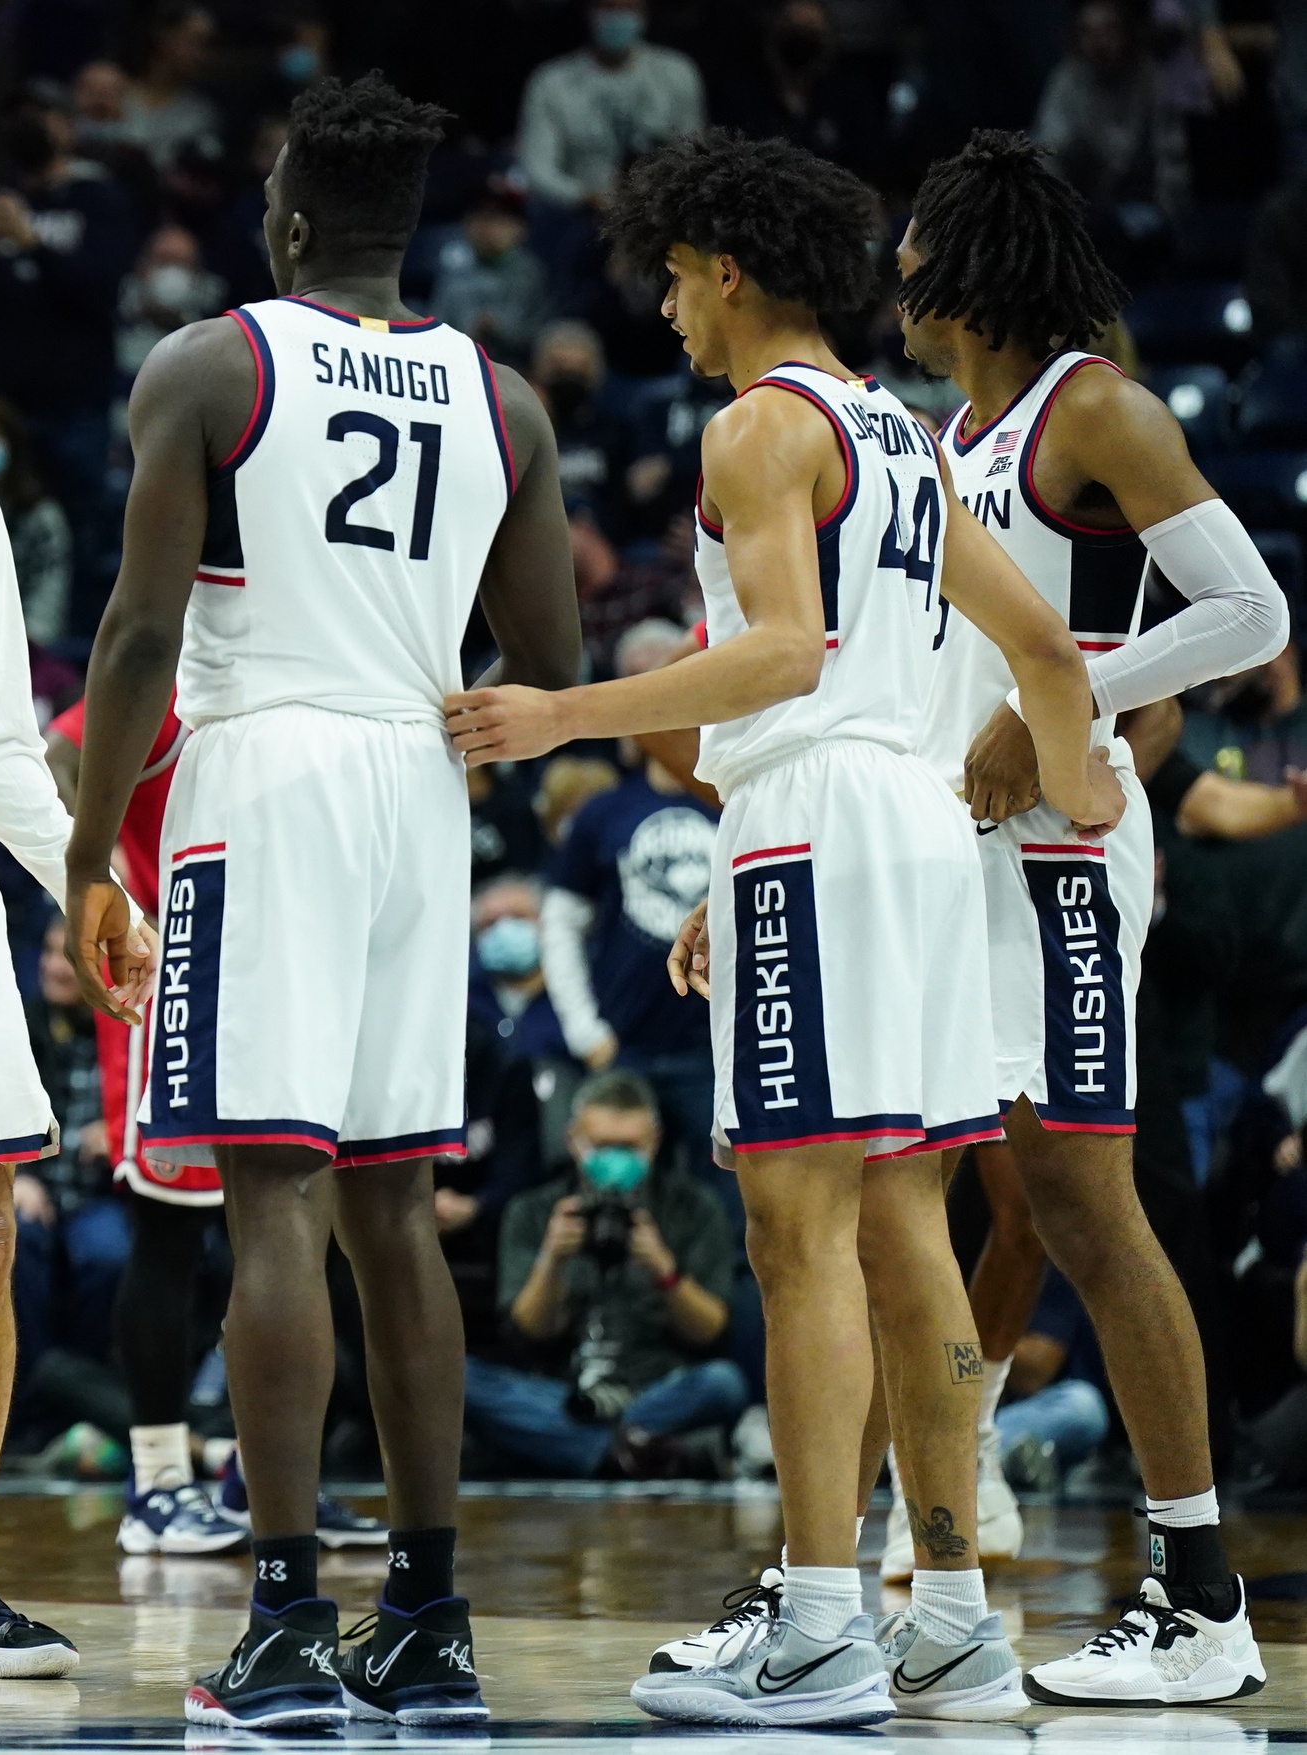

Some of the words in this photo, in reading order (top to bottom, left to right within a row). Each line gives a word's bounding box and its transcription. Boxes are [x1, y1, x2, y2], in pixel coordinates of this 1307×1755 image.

[312, 342, 450, 405] SANOGO
[325, 410, 442, 561] 21
[988, 462, 1013, 474] EAST
[992, 455, 1011, 466] BIG
[877, 466, 940, 612] 44
[163, 878, 195, 1109] HUSKIES
[754, 879, 800, 1110] HUSKIES
[1056, 876, 1106, 1093] HUSKIES
[258, 1559, 288, 1582] 23
